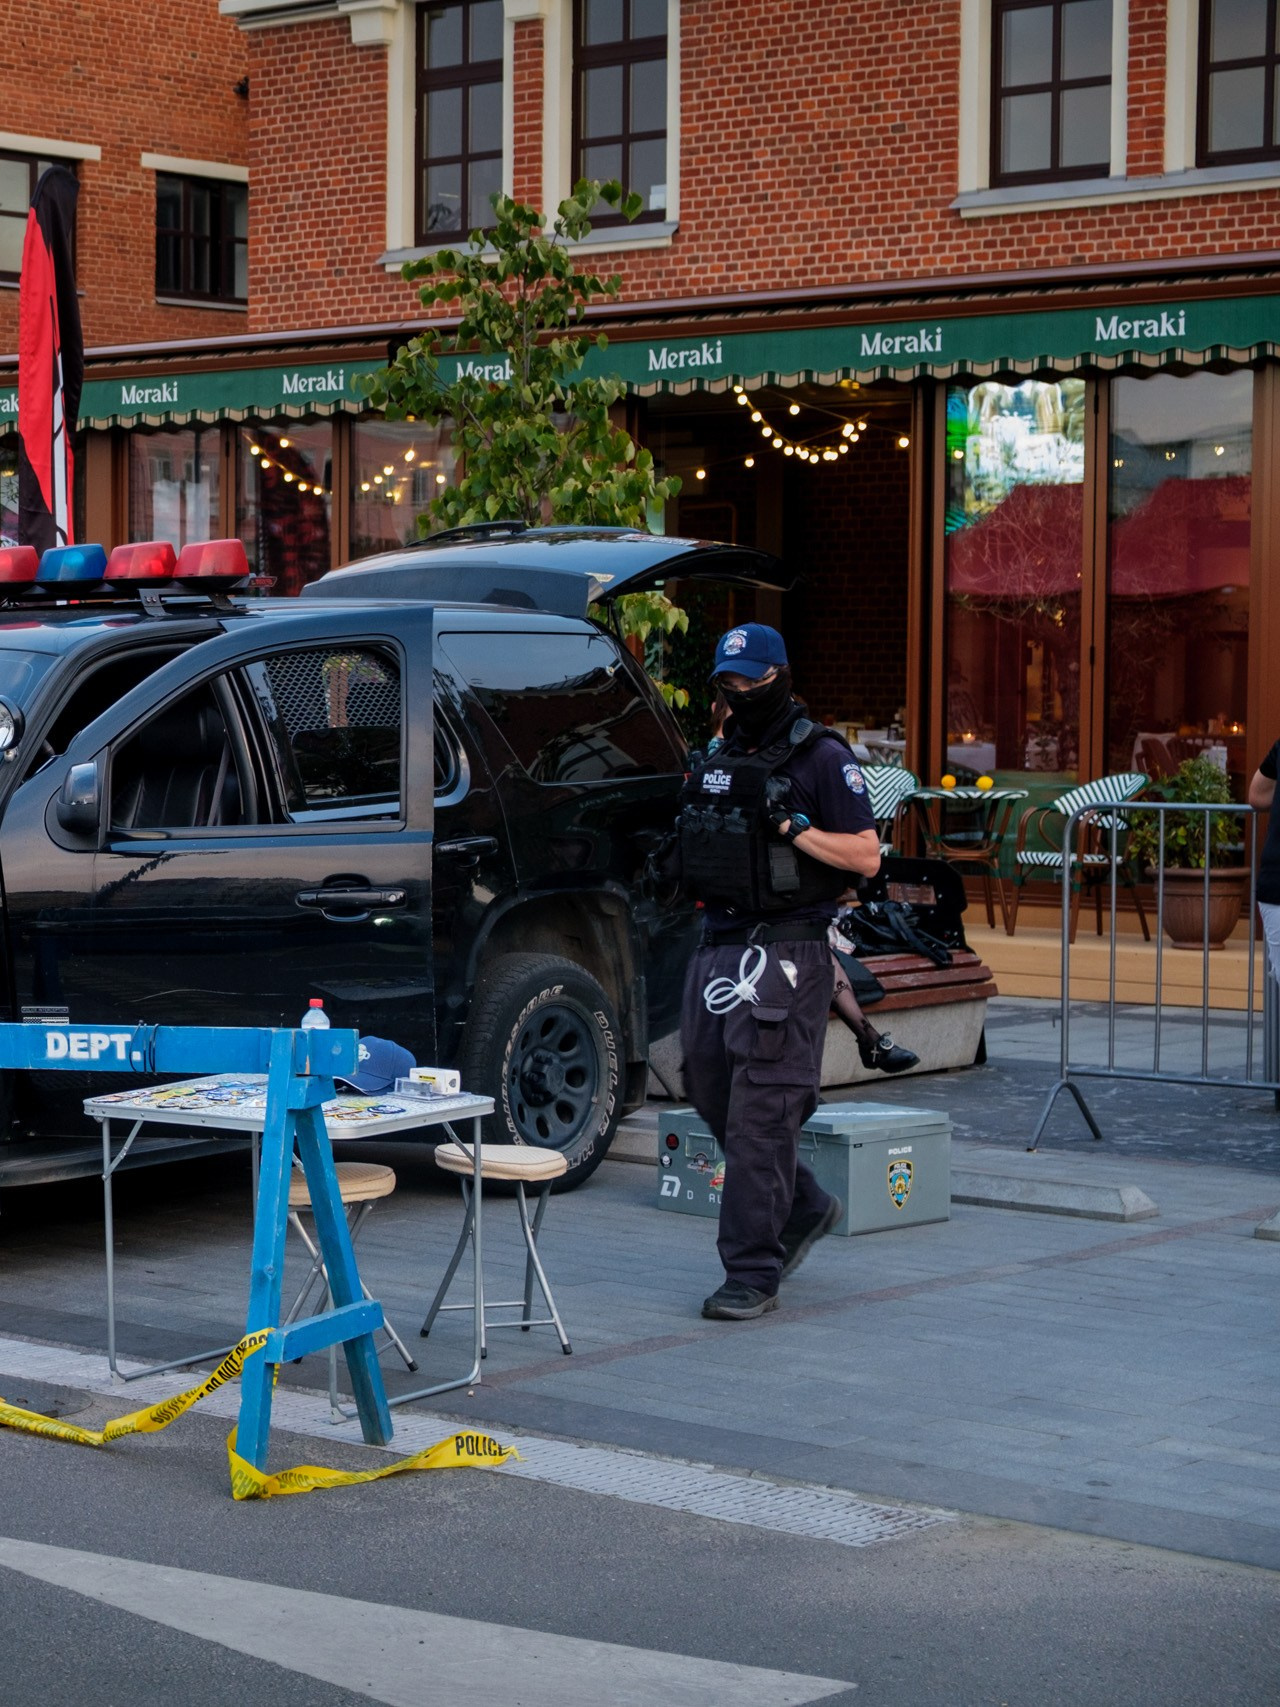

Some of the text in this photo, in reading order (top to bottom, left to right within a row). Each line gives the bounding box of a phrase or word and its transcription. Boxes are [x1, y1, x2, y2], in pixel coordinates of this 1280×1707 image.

[1095, 309, 1187, 342] Meraki
[859, 326, 943, 357] Meraki
[648, 340, 723, 372] Meraki
[281, 368, 345, 394] Meraki
[456, 359, 515, 382] Merak
[120, 381, 179, 405] Meraki
[703, 773, 732, 785] POLICE
[45, 1031, 142, 1061] DEPT.
[593, 1010, 619, 1137] DUELER
[888, 1146, 912, 1155] POLICE
[217, 1354, 242, 1381] NOT
